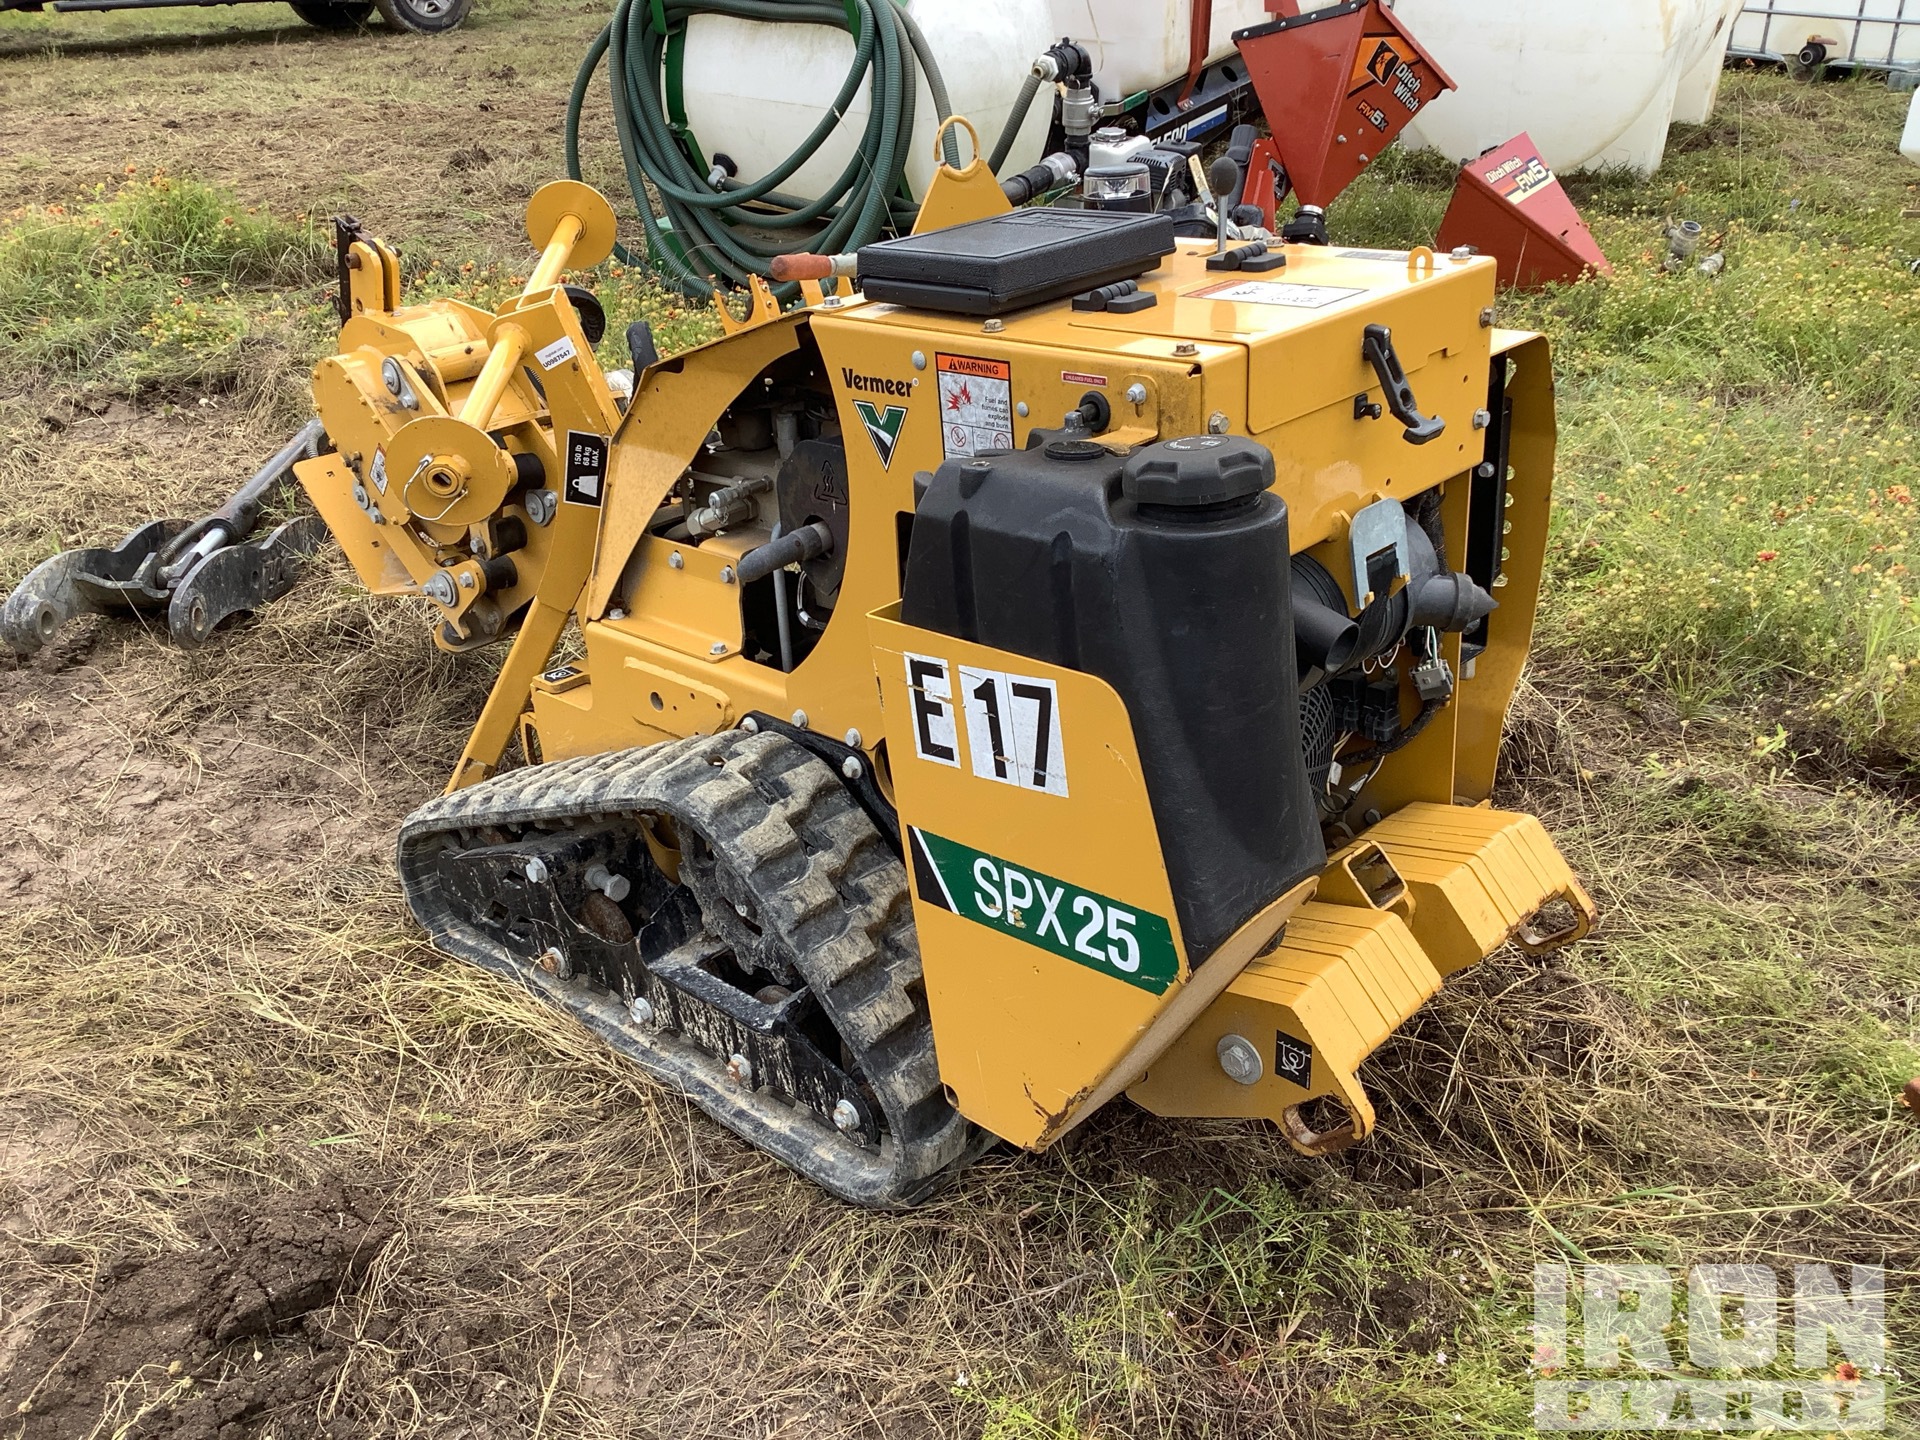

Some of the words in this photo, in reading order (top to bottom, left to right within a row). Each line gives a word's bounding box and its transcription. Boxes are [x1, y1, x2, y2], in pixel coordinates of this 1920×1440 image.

[1396, 63, 1421, 93] Ditch
[1394, 81, 1419, 113] Witch
[1485, 163, 1506, 183] Ditch
[1503, 156, 1524, 175] Witch
[1515, 159, 1547, 190] FM5
[543, 349, 571, 368] U0987547
[957, 360, 999, 375] WARNING
[842, 367, 912, 398] Vermeer
[985, 396, 996, 404] Fuel
[982, 404, 998, 412] fumes
[988, 413, 1009, 422] explode
[996, 421, 1009, 430] burn
[575, 444, 582, 452] lb
[583, 446, 592, 456] kg
[574, 453, 582, 465] 150
[583, 457, 590, 466] 68
[973, 857, 1140, 974] SPX25
